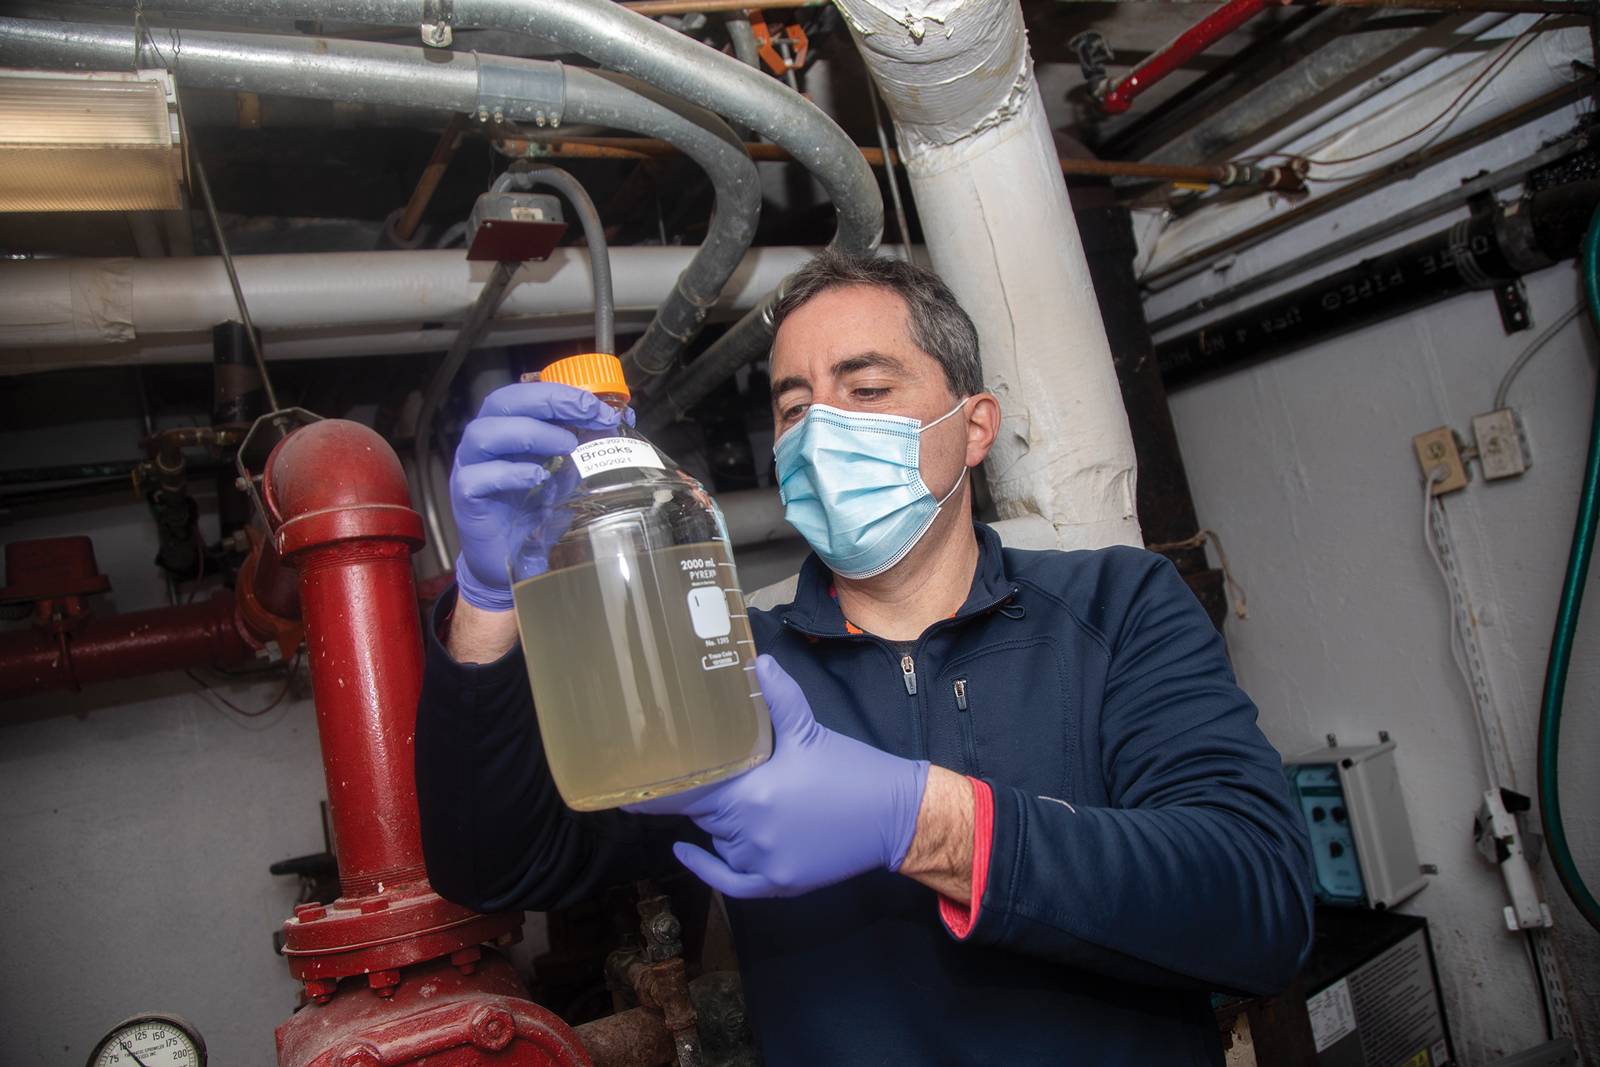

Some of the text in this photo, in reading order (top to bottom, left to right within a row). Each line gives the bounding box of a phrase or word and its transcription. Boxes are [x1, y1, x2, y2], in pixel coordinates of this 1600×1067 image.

[580, 445, 633, 462] Brooks
[584, 457, 632, 473] 3/10/2021
[680, 557, 716, 571] 2000 mL
[705, 639, 716, 647] No.
[134, 1030, 148, 1041] 125
[152, 1030, 166, 1041] 150
[119, 1040, 133, 1051] 100
[165, 1036, 178, 1048] 175
[109, 1053, 120, 1064] 75
[172, 1048, 188, 1060] 200
